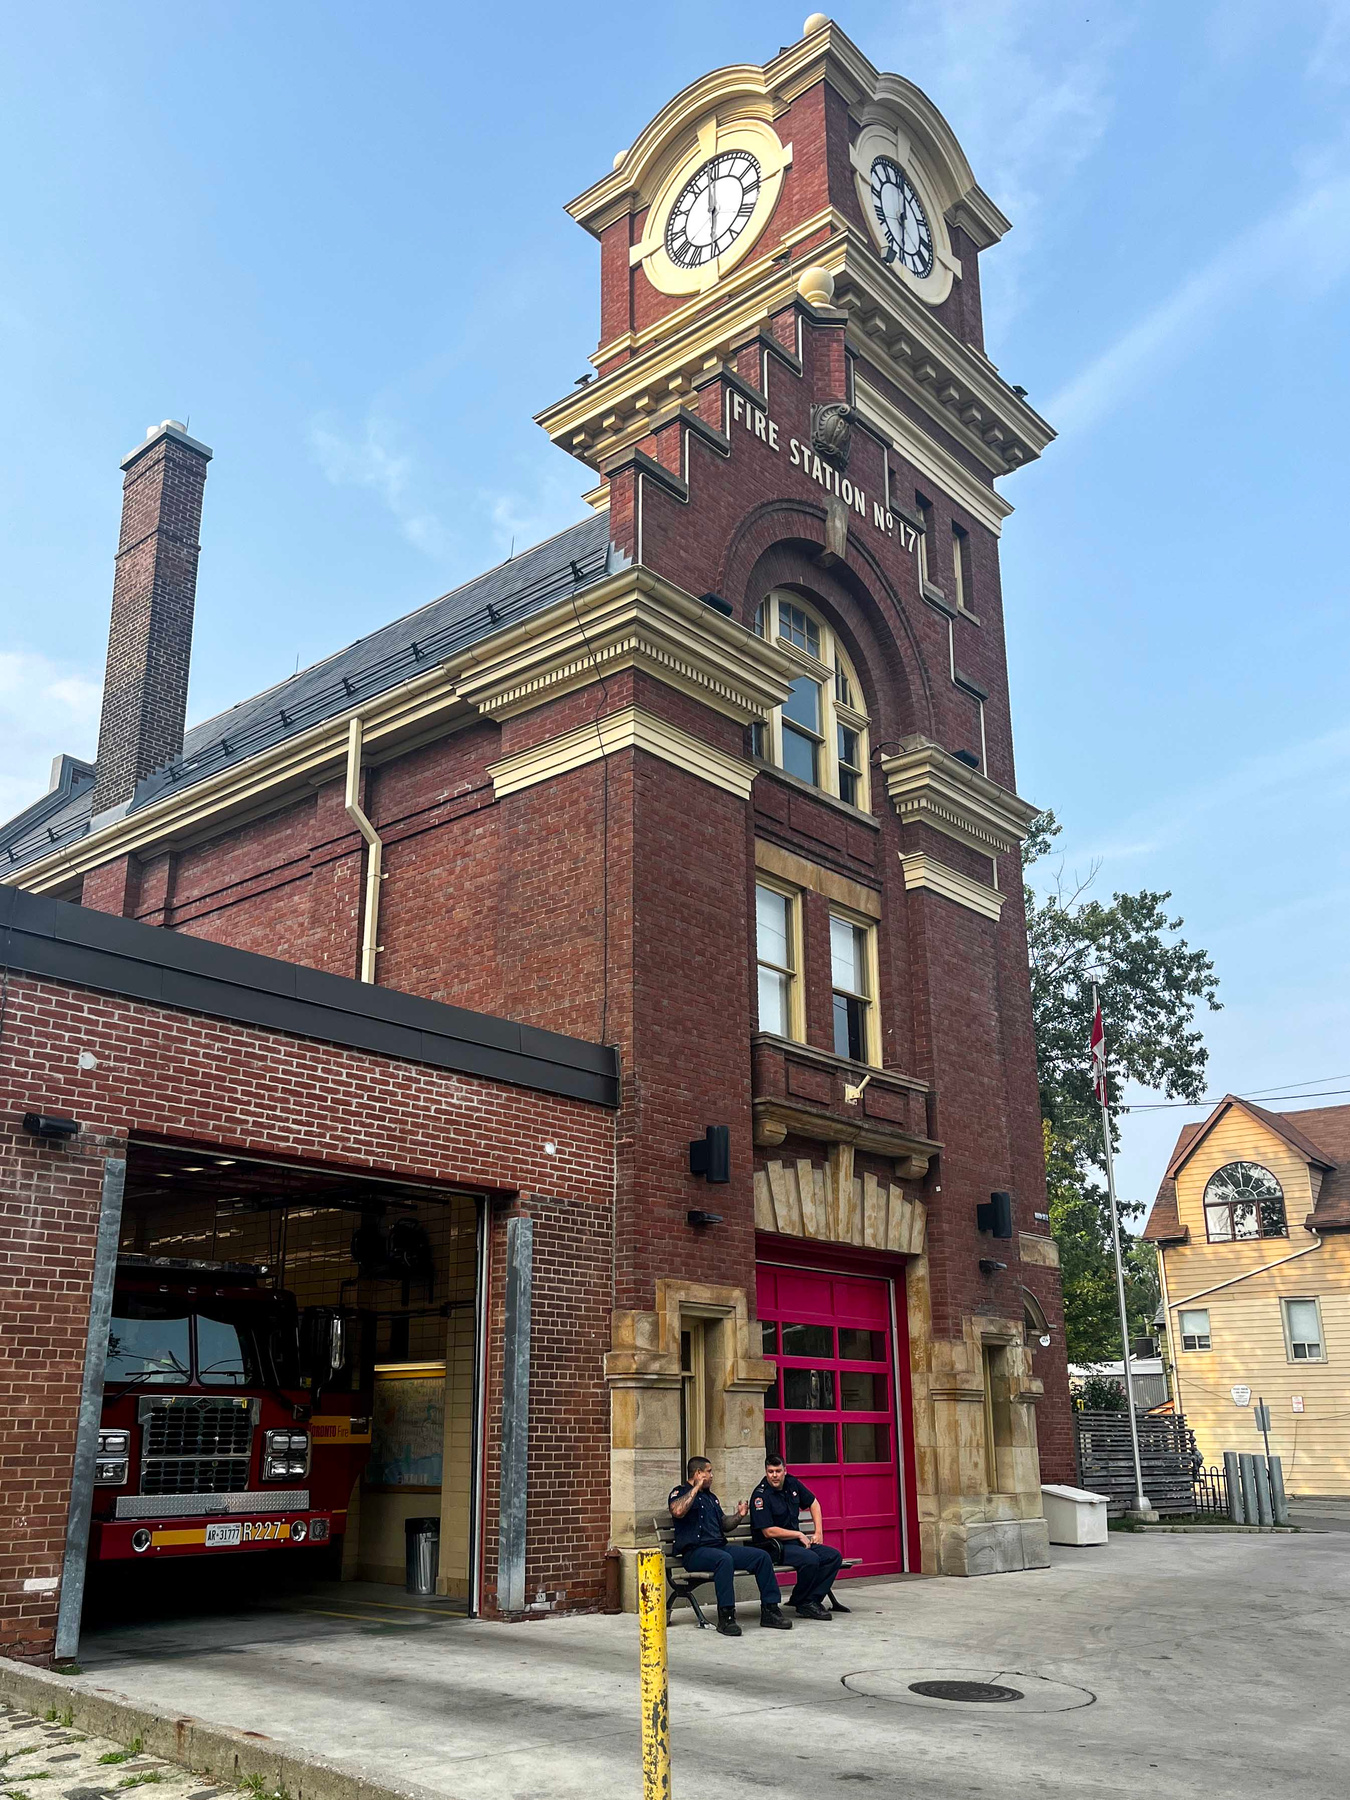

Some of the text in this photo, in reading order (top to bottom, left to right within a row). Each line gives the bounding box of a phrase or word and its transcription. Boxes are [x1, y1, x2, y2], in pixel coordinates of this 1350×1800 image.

[733, 393, 780, 452] FIRE
[789, 438, 866, 518] STATION
[899, 522, 916, 553] 17
[242, 1521, 281, 1541] R227
